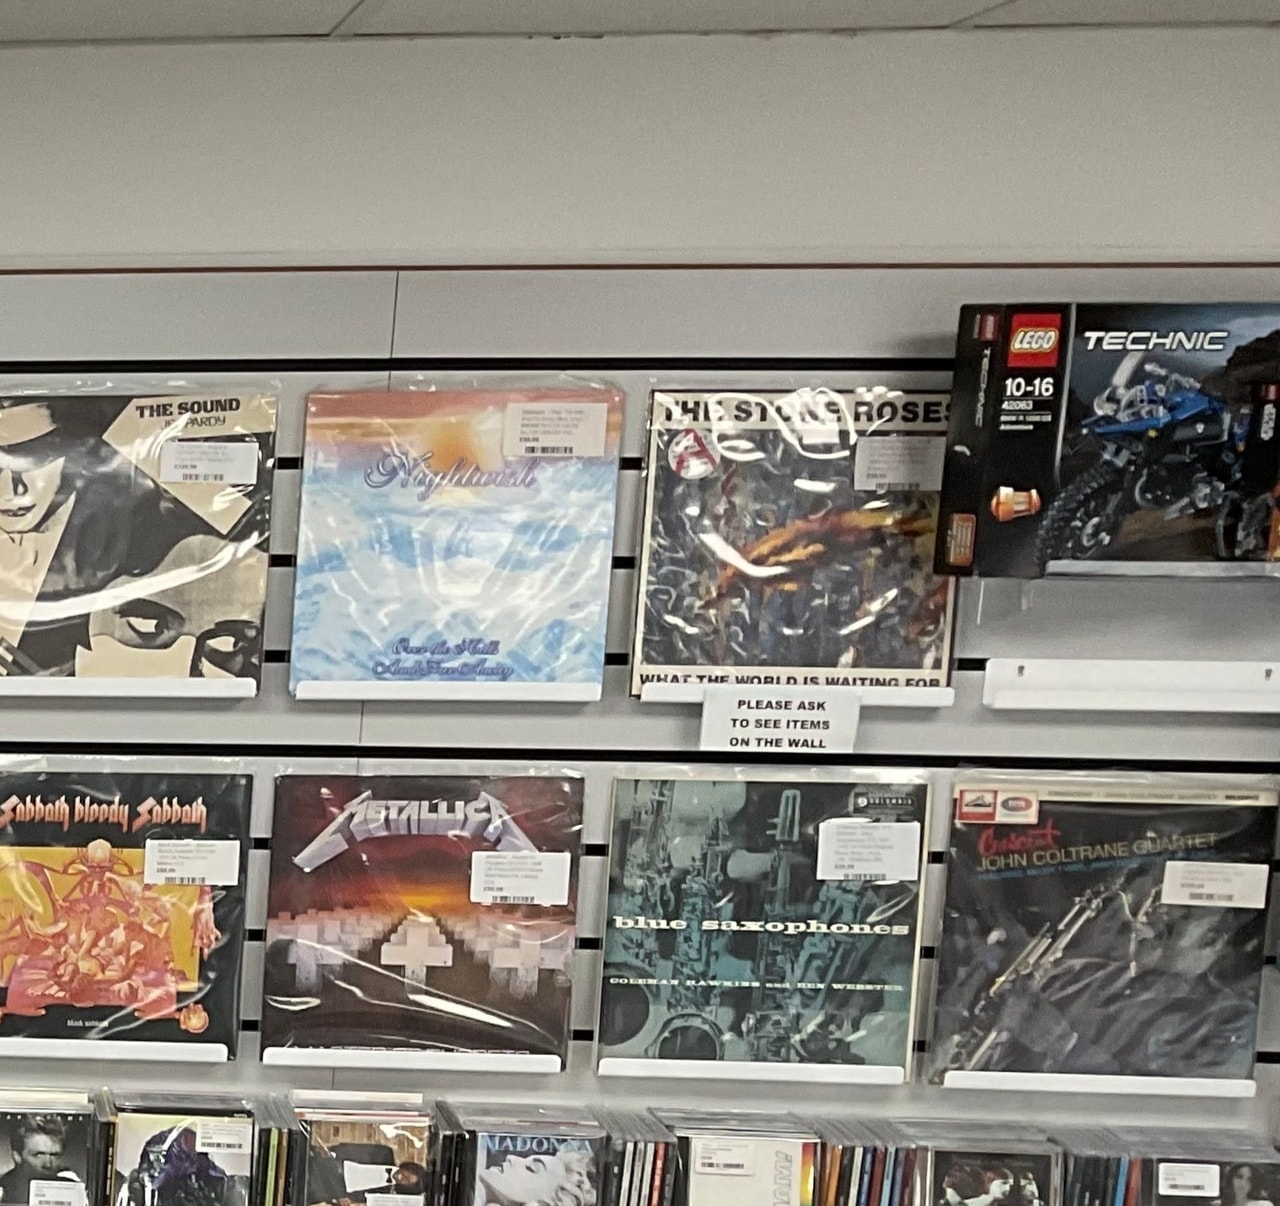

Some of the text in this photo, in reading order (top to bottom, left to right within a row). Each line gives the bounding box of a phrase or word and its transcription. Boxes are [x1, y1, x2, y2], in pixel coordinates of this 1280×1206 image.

[1015, 329, 1057, 350] LEGO
[1084, 331, 1229, 351] TECHNIC
[1004, 377, 1054, 397] 10-16
[136, 398, 241, 419] THE SOUND
[1001, 400, 1033, 411] 42063
[365, 448, 537, 499] Nightwish
[737, 700, 826, 711] PLEASE ASK
[730, 718, 830, 730] TO SEE ITEMS
[729, 737, 826, 749] ON THE WALL
[74, 795, 130, 832] bloody
[132, 795, 207, 833] Sabbath
[292, 789, 540, 872] METALLICA
[977, 832, 1218, 872] JOHN COLTRANE QUARTET
[613, 915, 910, 937] blue saxophones
